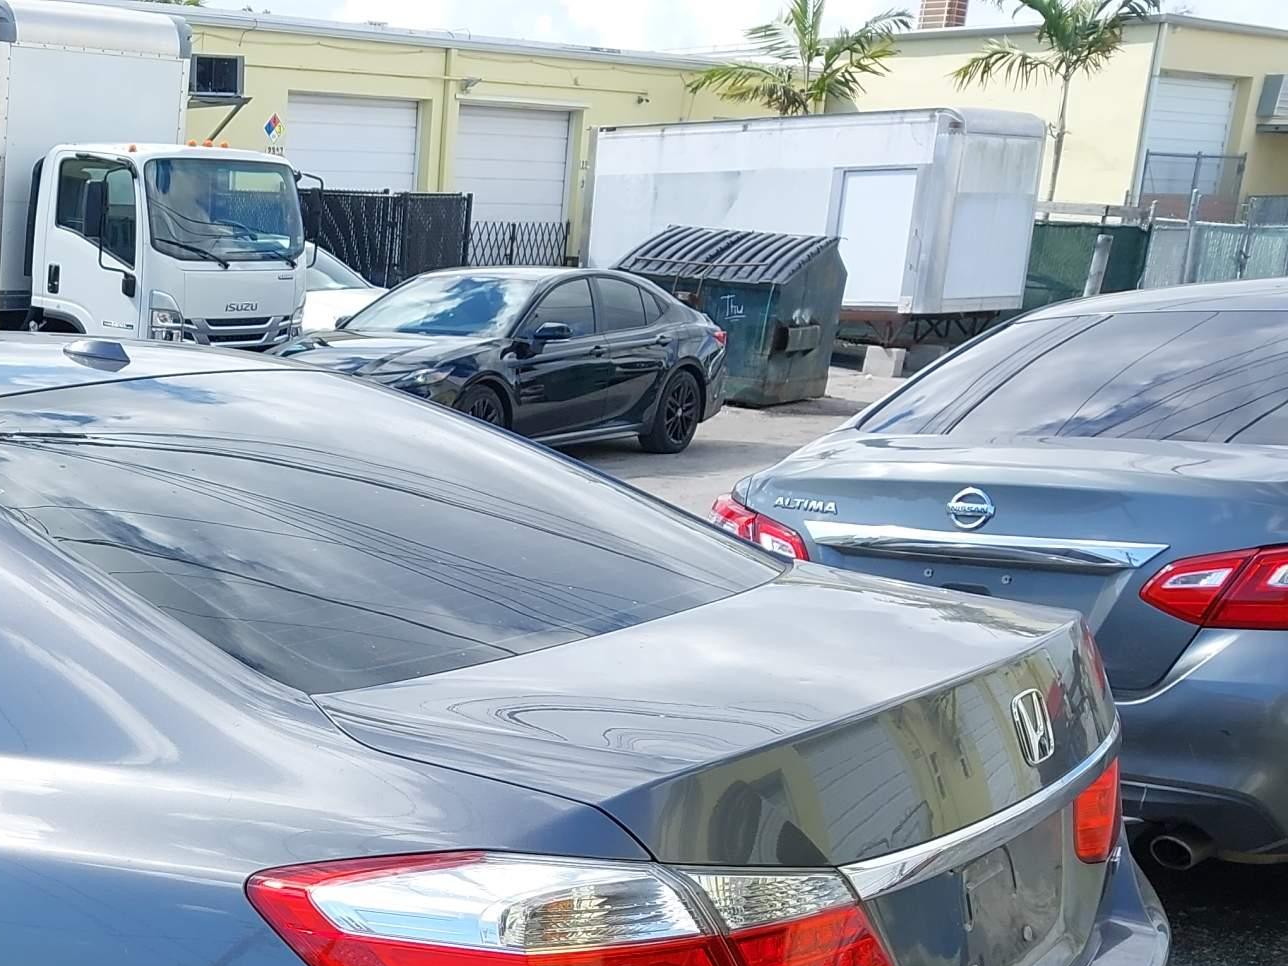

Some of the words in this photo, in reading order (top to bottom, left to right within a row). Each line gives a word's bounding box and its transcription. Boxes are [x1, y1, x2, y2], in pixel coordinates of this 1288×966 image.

[225, 303, 258, 312] ISUZU
[720, 294, 744, 317] Thu
[774, 496, 838, 515] ALTIMA
[949, 503, 992, 514] NISSAN
